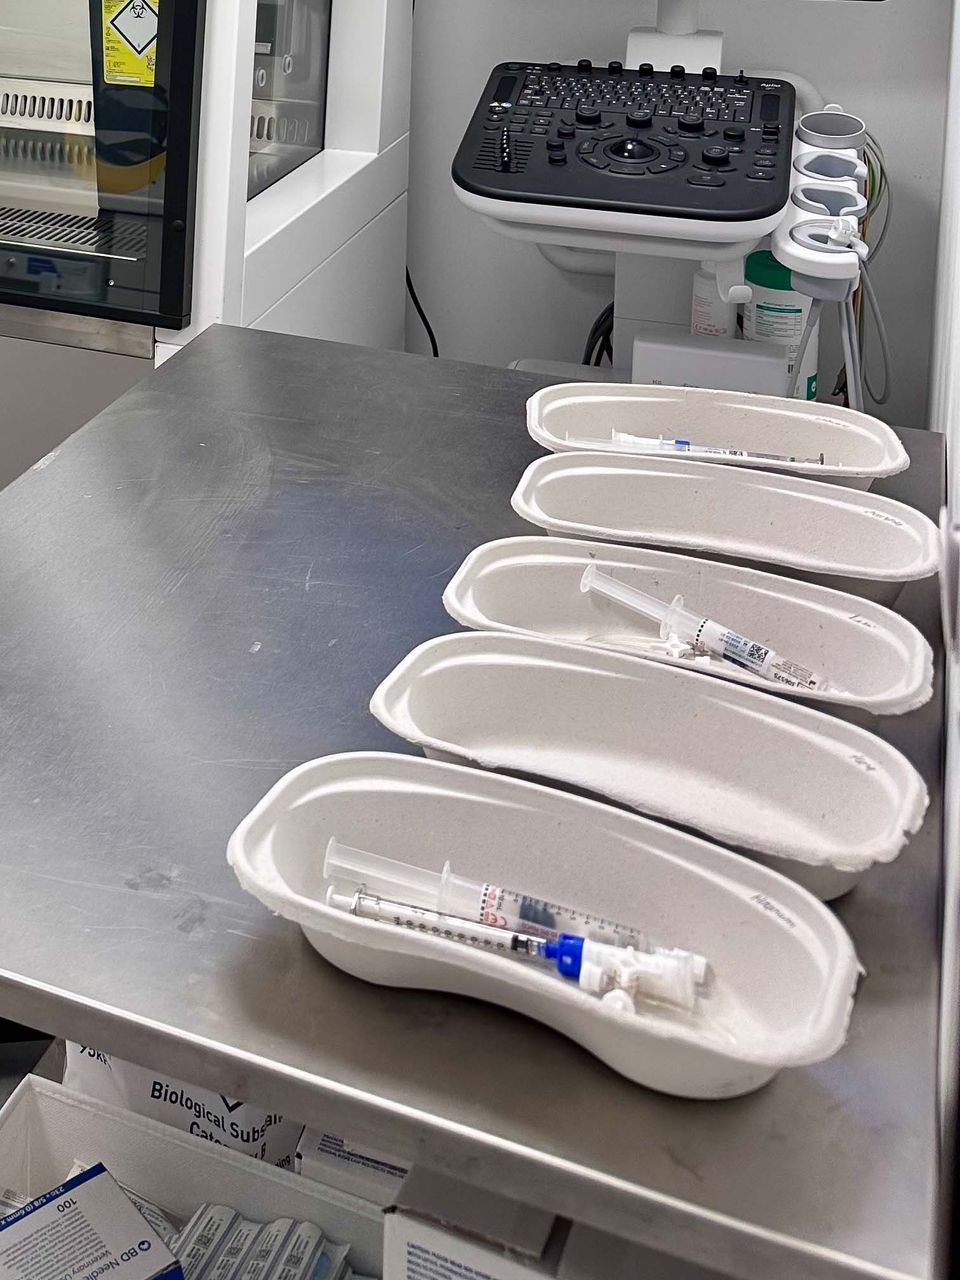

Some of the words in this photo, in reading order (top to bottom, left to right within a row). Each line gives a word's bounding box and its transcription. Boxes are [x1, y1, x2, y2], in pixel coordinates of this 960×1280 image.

[150, 1080, 226, 1133] Biological
[55, 1196, 78, 1214] 100
[119, 1246, 139, 1263] BD
